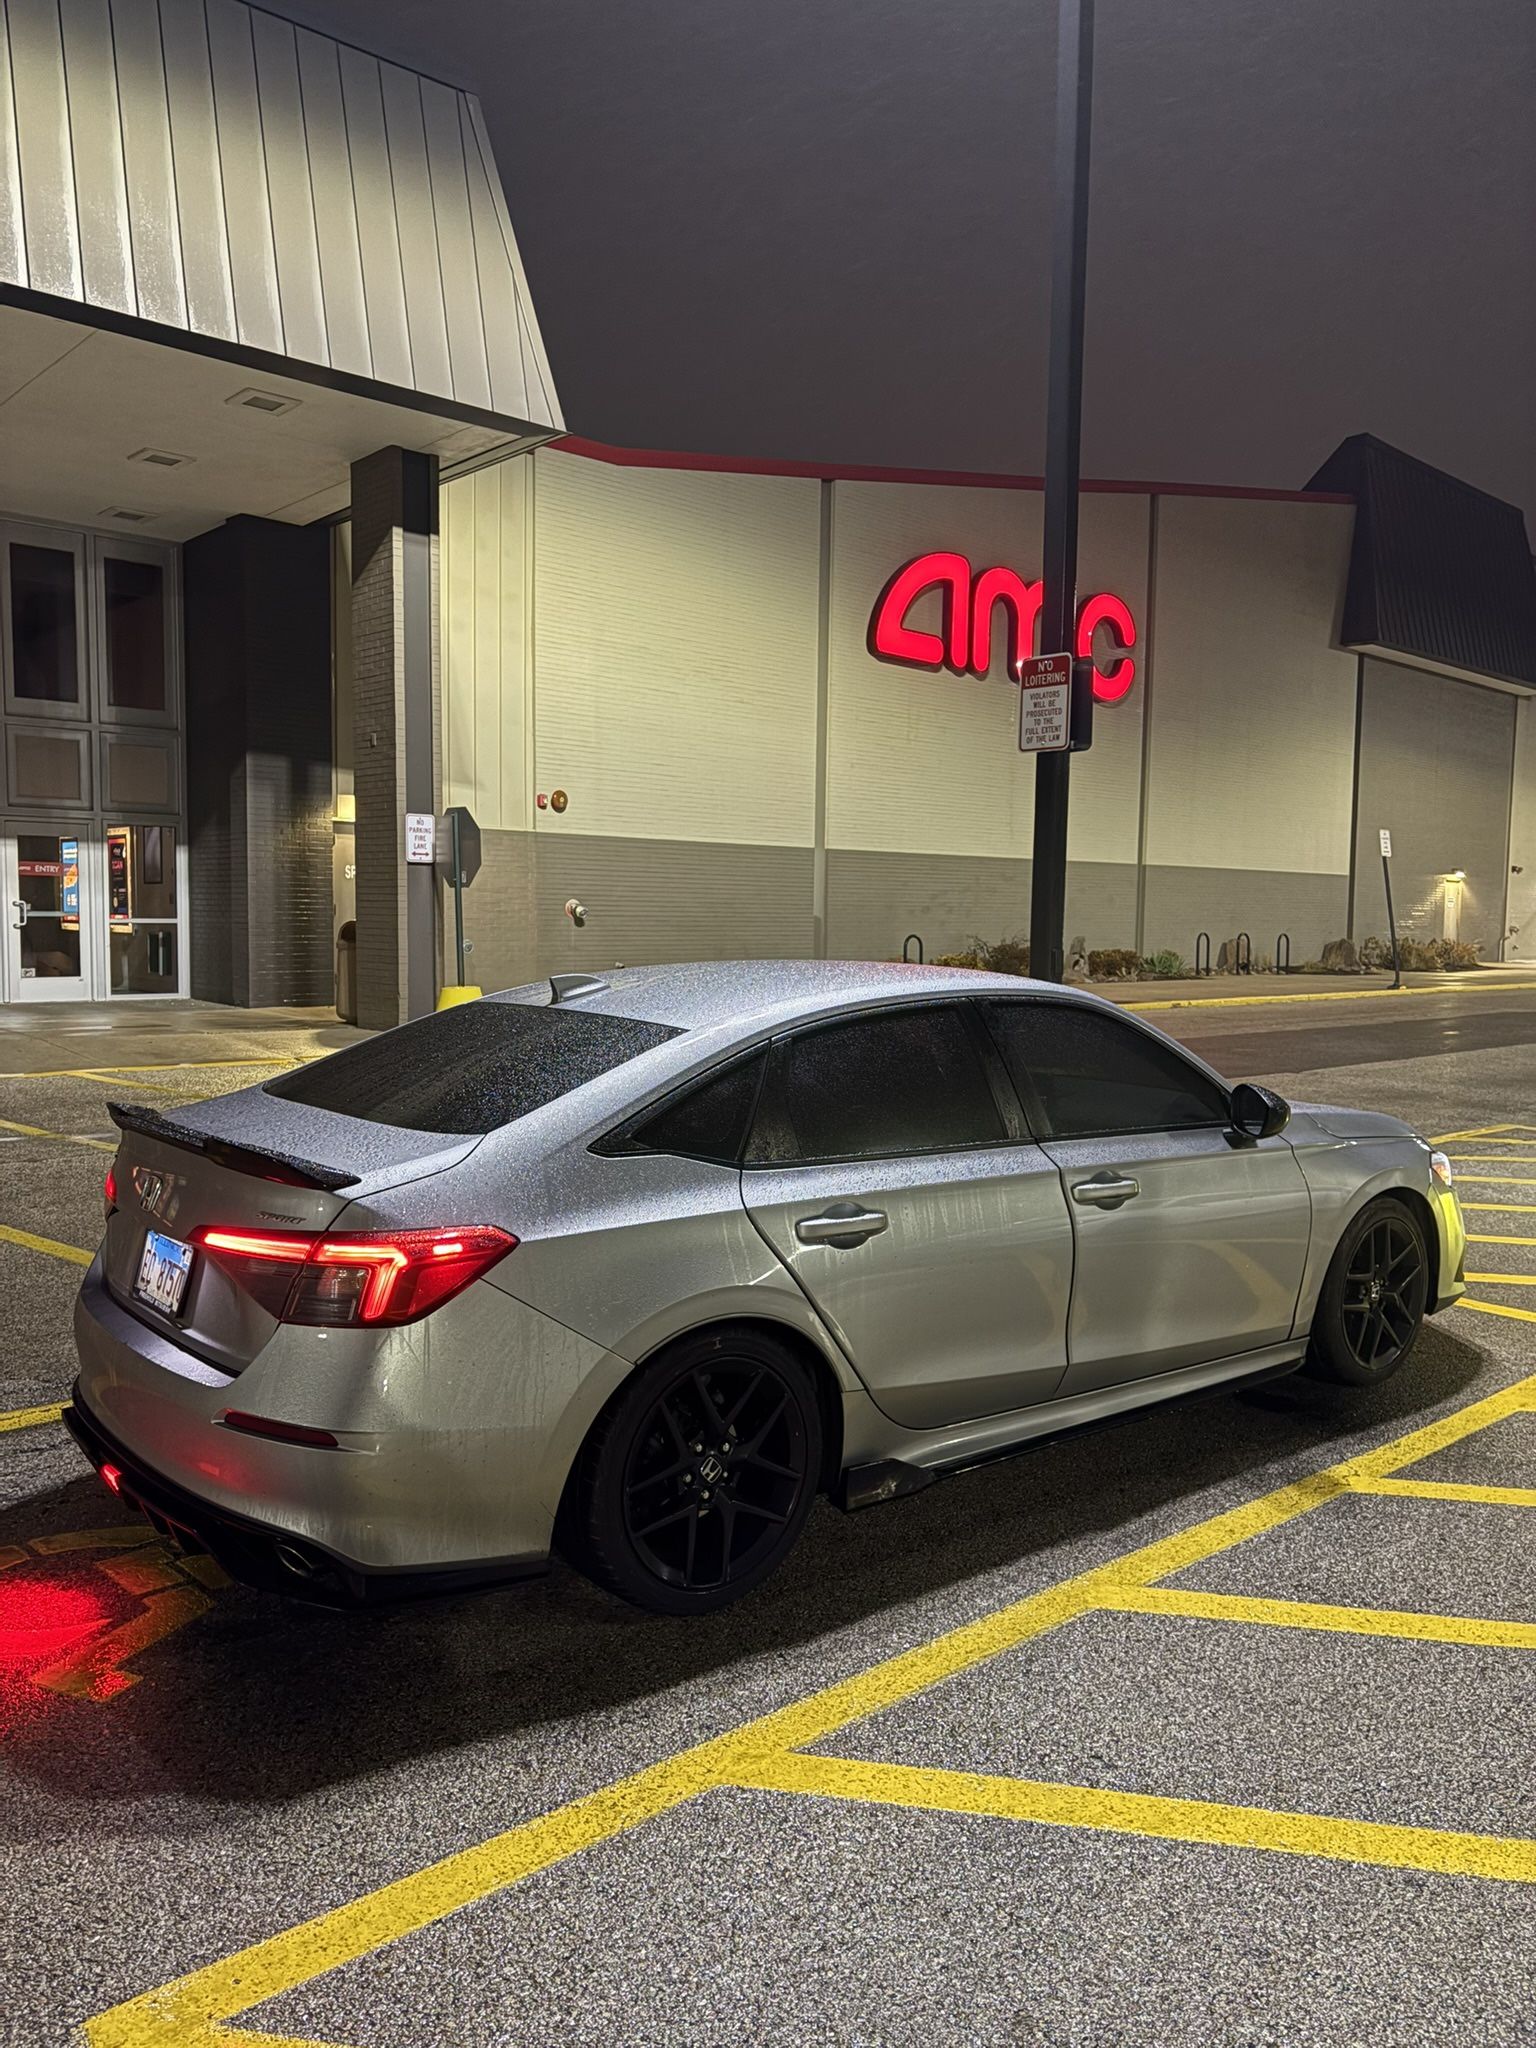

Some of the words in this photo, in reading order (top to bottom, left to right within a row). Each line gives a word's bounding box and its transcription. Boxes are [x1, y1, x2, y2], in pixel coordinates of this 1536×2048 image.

[1038, 660, 1053, 672] NO
[1025, 671, 1066, 687] LOITERING
[1030, 690, 1060, 700] VIOLATORS
[1048, 699, 1056, 707] BE
[1026, 708, 1062, 718] PROSECUTED
[1034, 718, 1041, 726] TO
[1043, 717, 1053, 725] THE
[1025, 727, 1039, 736] FULL
[1041, 725, 1062, 734] EXTENT
[1026, 736, 1034, 744] OF
[1036, 735, 1046, 743] THE
[1048, 734, 1060, 742] LAW
[34, 864, 60, 873] ENTRY
[256, 1210, 307, 1225] SPORT
